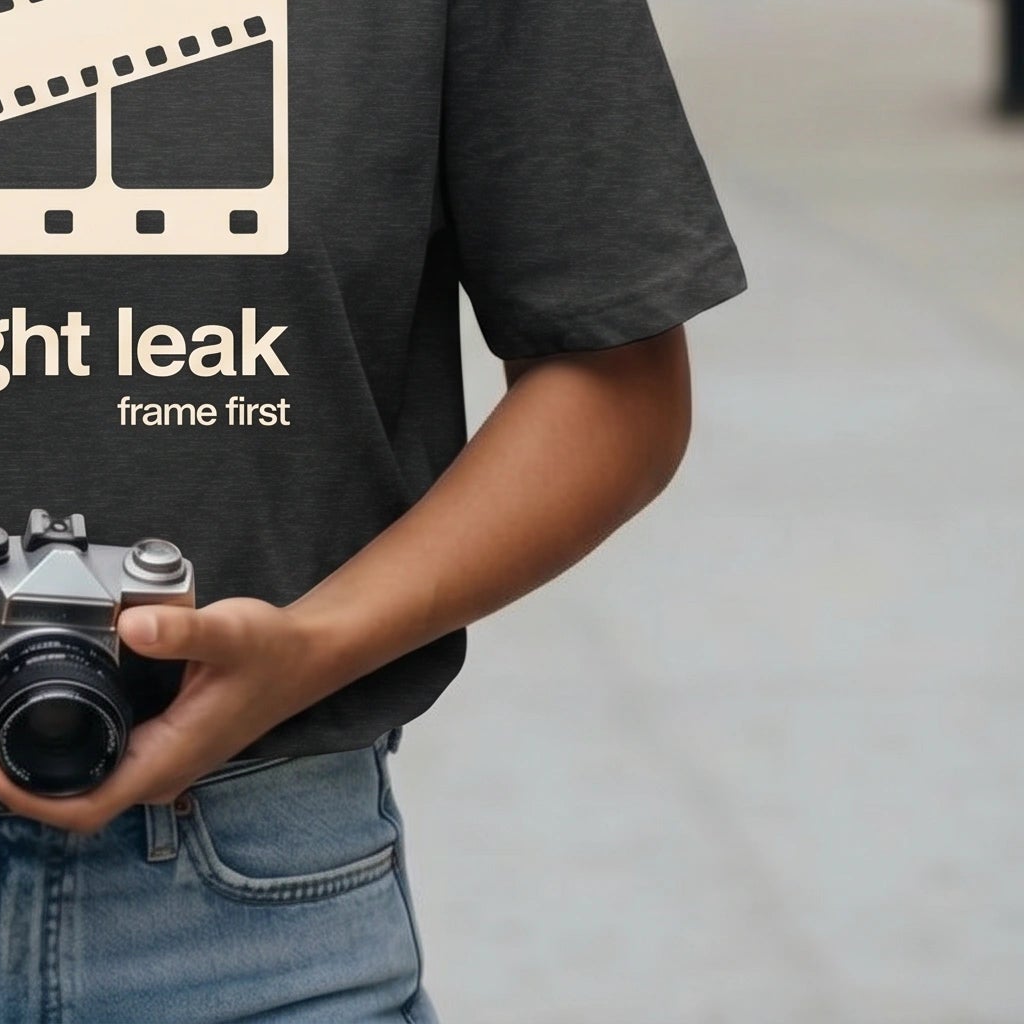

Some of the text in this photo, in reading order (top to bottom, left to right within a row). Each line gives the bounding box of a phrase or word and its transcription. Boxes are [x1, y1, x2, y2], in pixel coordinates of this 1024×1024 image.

[118, 307, 290, 377] leak
[118, 395, 291, 426] frame first
